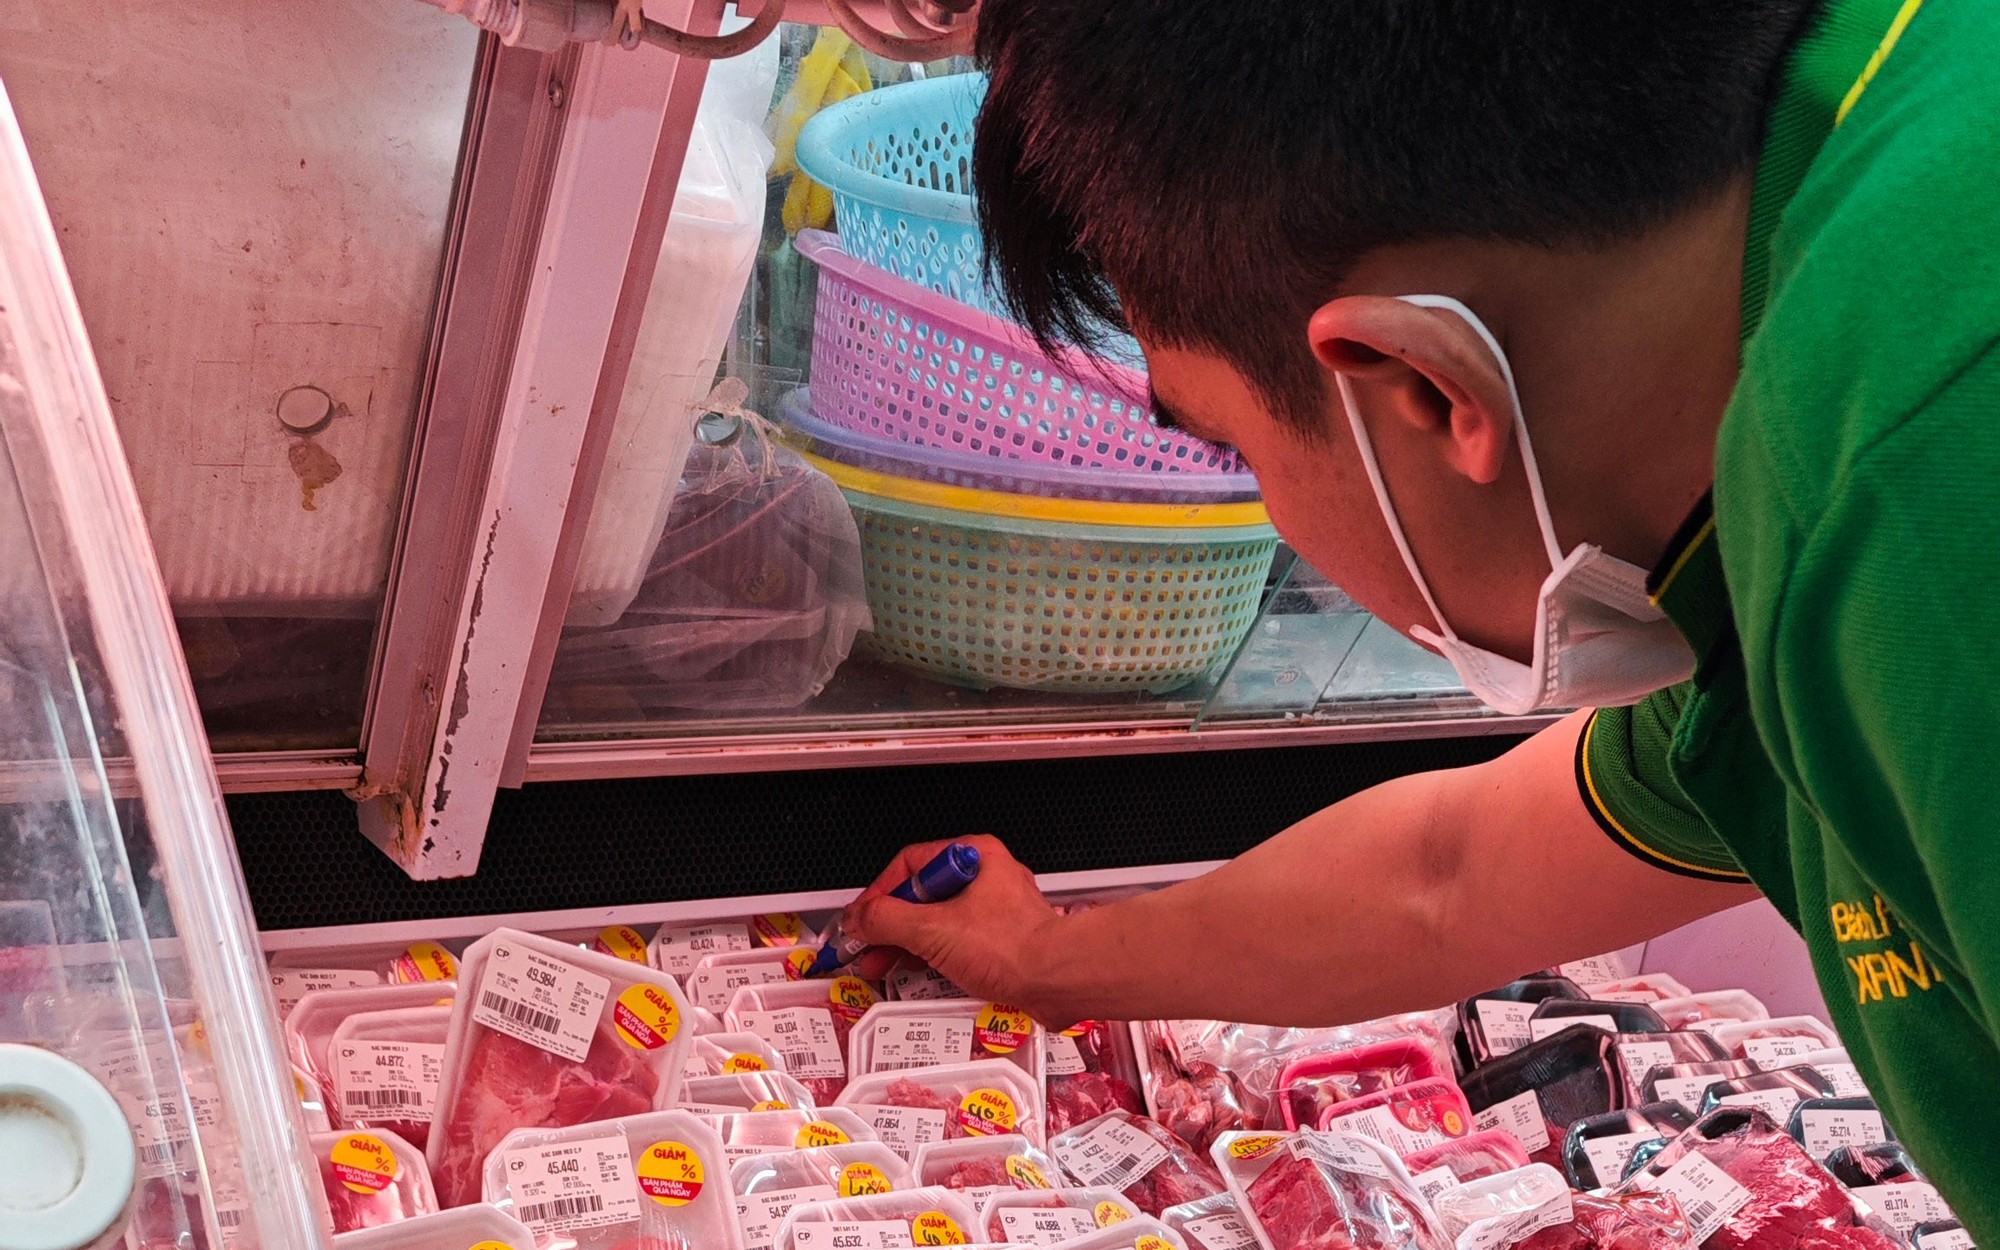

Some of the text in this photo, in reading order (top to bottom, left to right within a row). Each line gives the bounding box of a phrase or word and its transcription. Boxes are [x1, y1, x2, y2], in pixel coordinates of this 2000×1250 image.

[690, 938, 715, 951] 40.424
[496, 948, 510, 958] CP
[526, 966, 558, 988] 49.984
[1847, 940, 1943, 1005] XAN
[272, 977, 284, 985] CP
[644, 988, 673, 1015] GIẢM
[654, 1016, 673, 1034] %
[774, 1021, 798, 1034] 49.104
[878, 1026, 890, 1034] CP
[1014, 1018, 1026, 1031] %
[905, 1031, 930, 1041] 40.920
[342, 1049, 355, 1058] CP
[376, 1055, 405, 1067] 44.872
[735, 1058, 761, 1071] GIẢM
[980, 1092, 1008, 1110] GIẢM
[873, 1118, 899, 1130] 47.864
[997, 1111, 1011, 1125] %
[810, 1125, 839, 1138] GIẢM
[350, 1139, 381, 1155] GIẢM
[653, 1146, 686, 1161] GIẢM
[375, 1157, 390, 1172] %
[510, 1160, 524, 1171] CP
[547, 1159, 579, 1175] 45.440
[681, 1163, 696, 1179] %
[847, 1168, 872, 1180] GIẢM
[1885, 1198, 1909, 1211] 81.174
[769, 1205, 793, 1219] 54.81
[1099, 1205, 1113, 1224] GIẢM
[920, 1216, 947, 1229] GIẢM
[1005, 1216, 1016, 1224] CP
[1035, 1220, 1060, 1231] 44.888
[798, 1232, 810, 1241] CP
[832, 1236, 862, 1248] 45.632
[945, 1231, 959, 1244] %
